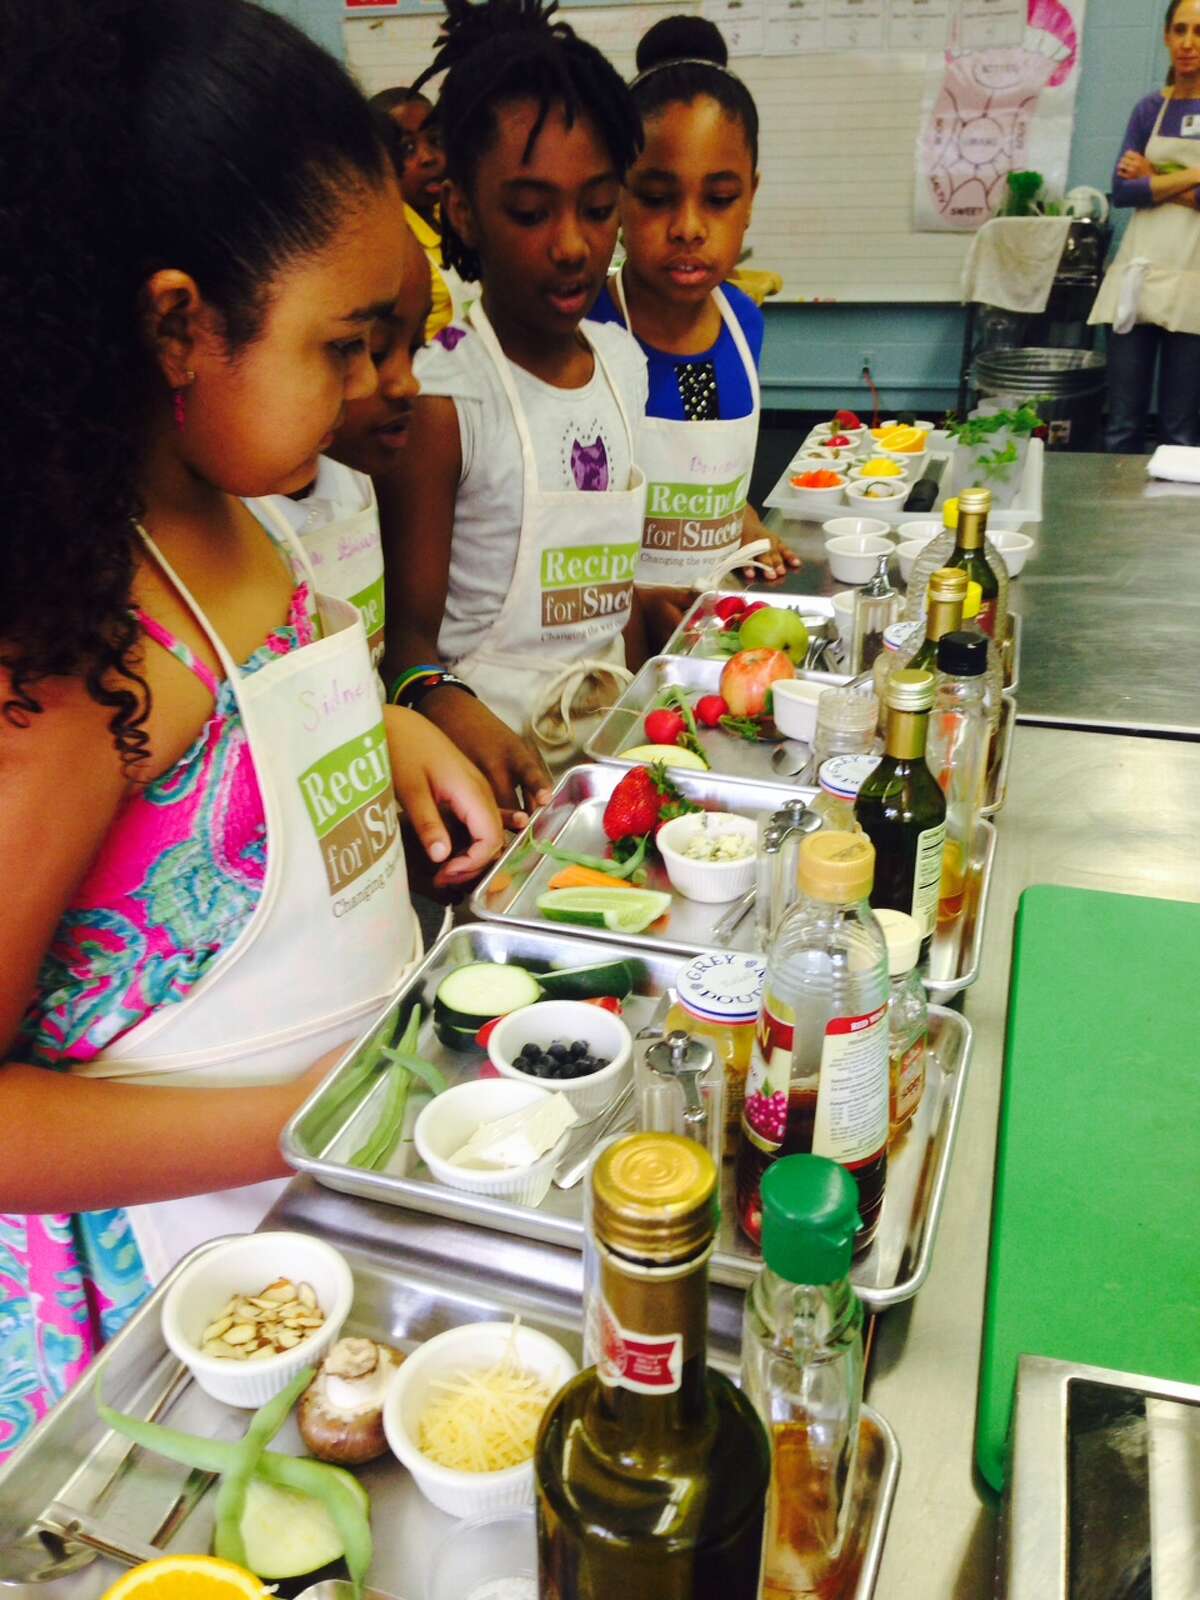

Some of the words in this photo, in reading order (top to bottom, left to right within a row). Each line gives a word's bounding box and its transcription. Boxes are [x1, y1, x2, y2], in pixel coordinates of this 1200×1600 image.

[950, 207, 984, 217] SWEET
[646, 524, 676, 546] for
[641, 553, 685, 567] Changing
[545, 596, 576, 623] for
[328, 838, 363, 885] for
[686, 954, 738, 981] GREY
